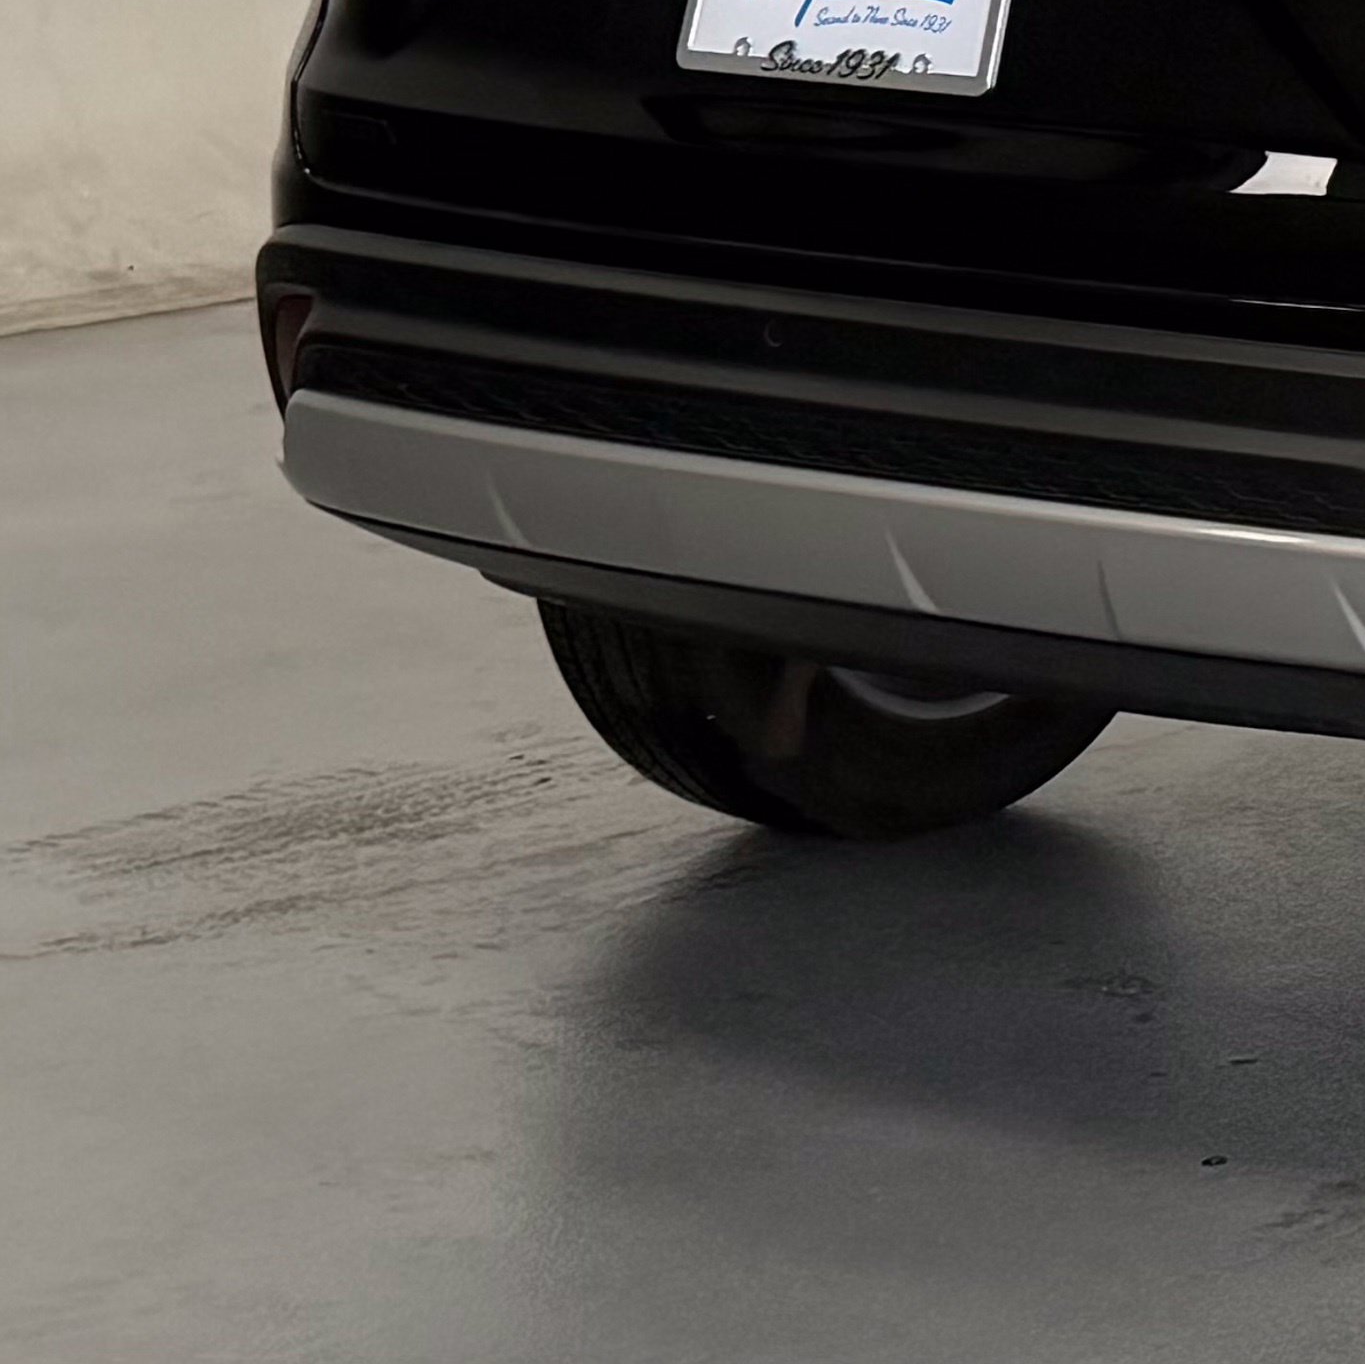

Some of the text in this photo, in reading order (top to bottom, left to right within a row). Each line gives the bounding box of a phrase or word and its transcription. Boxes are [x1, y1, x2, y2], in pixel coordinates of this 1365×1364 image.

[920, 13, 952, 33] 1931
[760, 40, 901, 80] Since 1931
